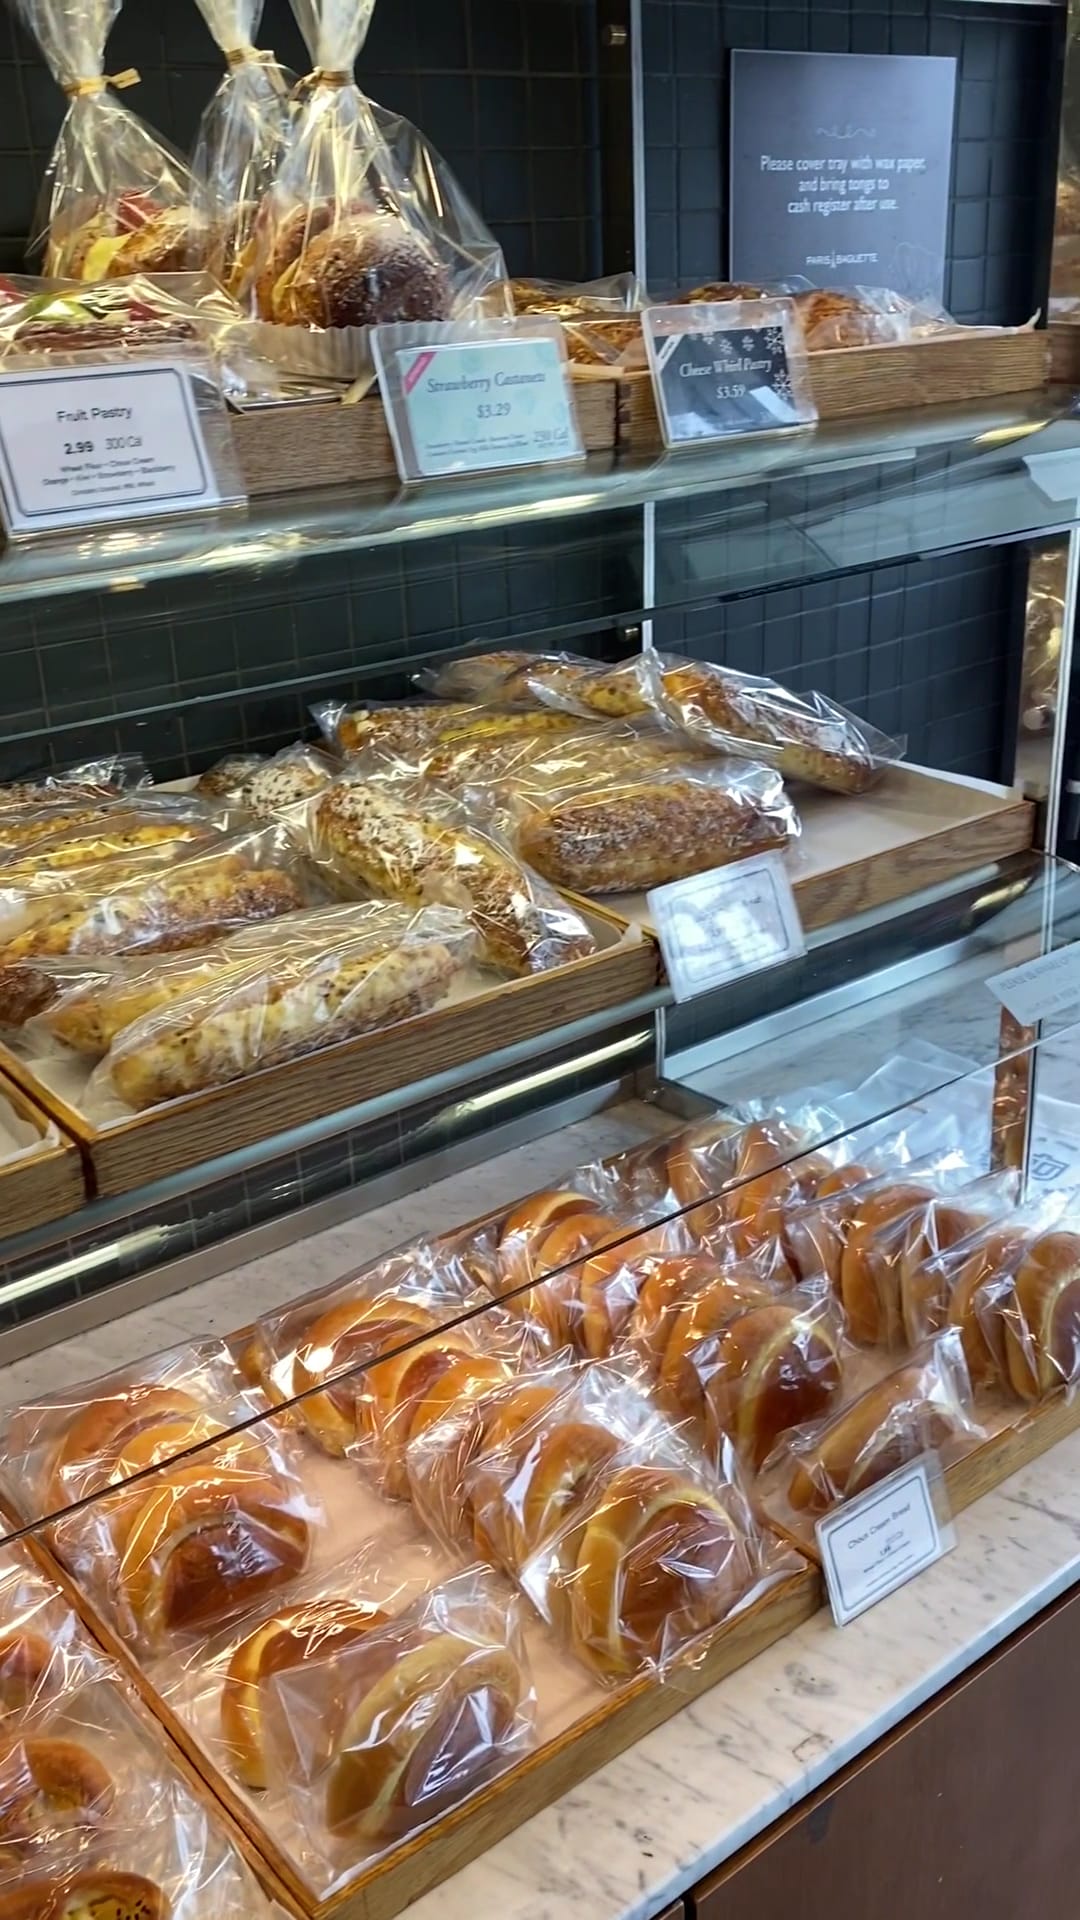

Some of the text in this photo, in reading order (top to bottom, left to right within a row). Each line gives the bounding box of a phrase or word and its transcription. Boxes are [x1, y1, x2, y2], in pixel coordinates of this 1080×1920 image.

[760, 154, 793, 171] Please
[796, 158, 825, 171] cover
[827, 158, 848, 174] tray
[850, 154, 873, 171] with
[875, 158, 895, 170] wax
[798, 175, 890, 195] and bring tongs to
[787, 197, 810, 213] cash
[812, 198, 850, 216] register
[852, 196, 878, 212] after
[806, 252, 878, 266] PARIS BAGUETTE
[679, 356, 772, 378] Cheese Whirl Pastry
[425, 374, 490, 394] Strawberry
[56, 405, 133, 423] Fruit Pastry
[476, 401, 511, 419] $3.29
[64, 435, 143, 455] 2.99 300 Cal
